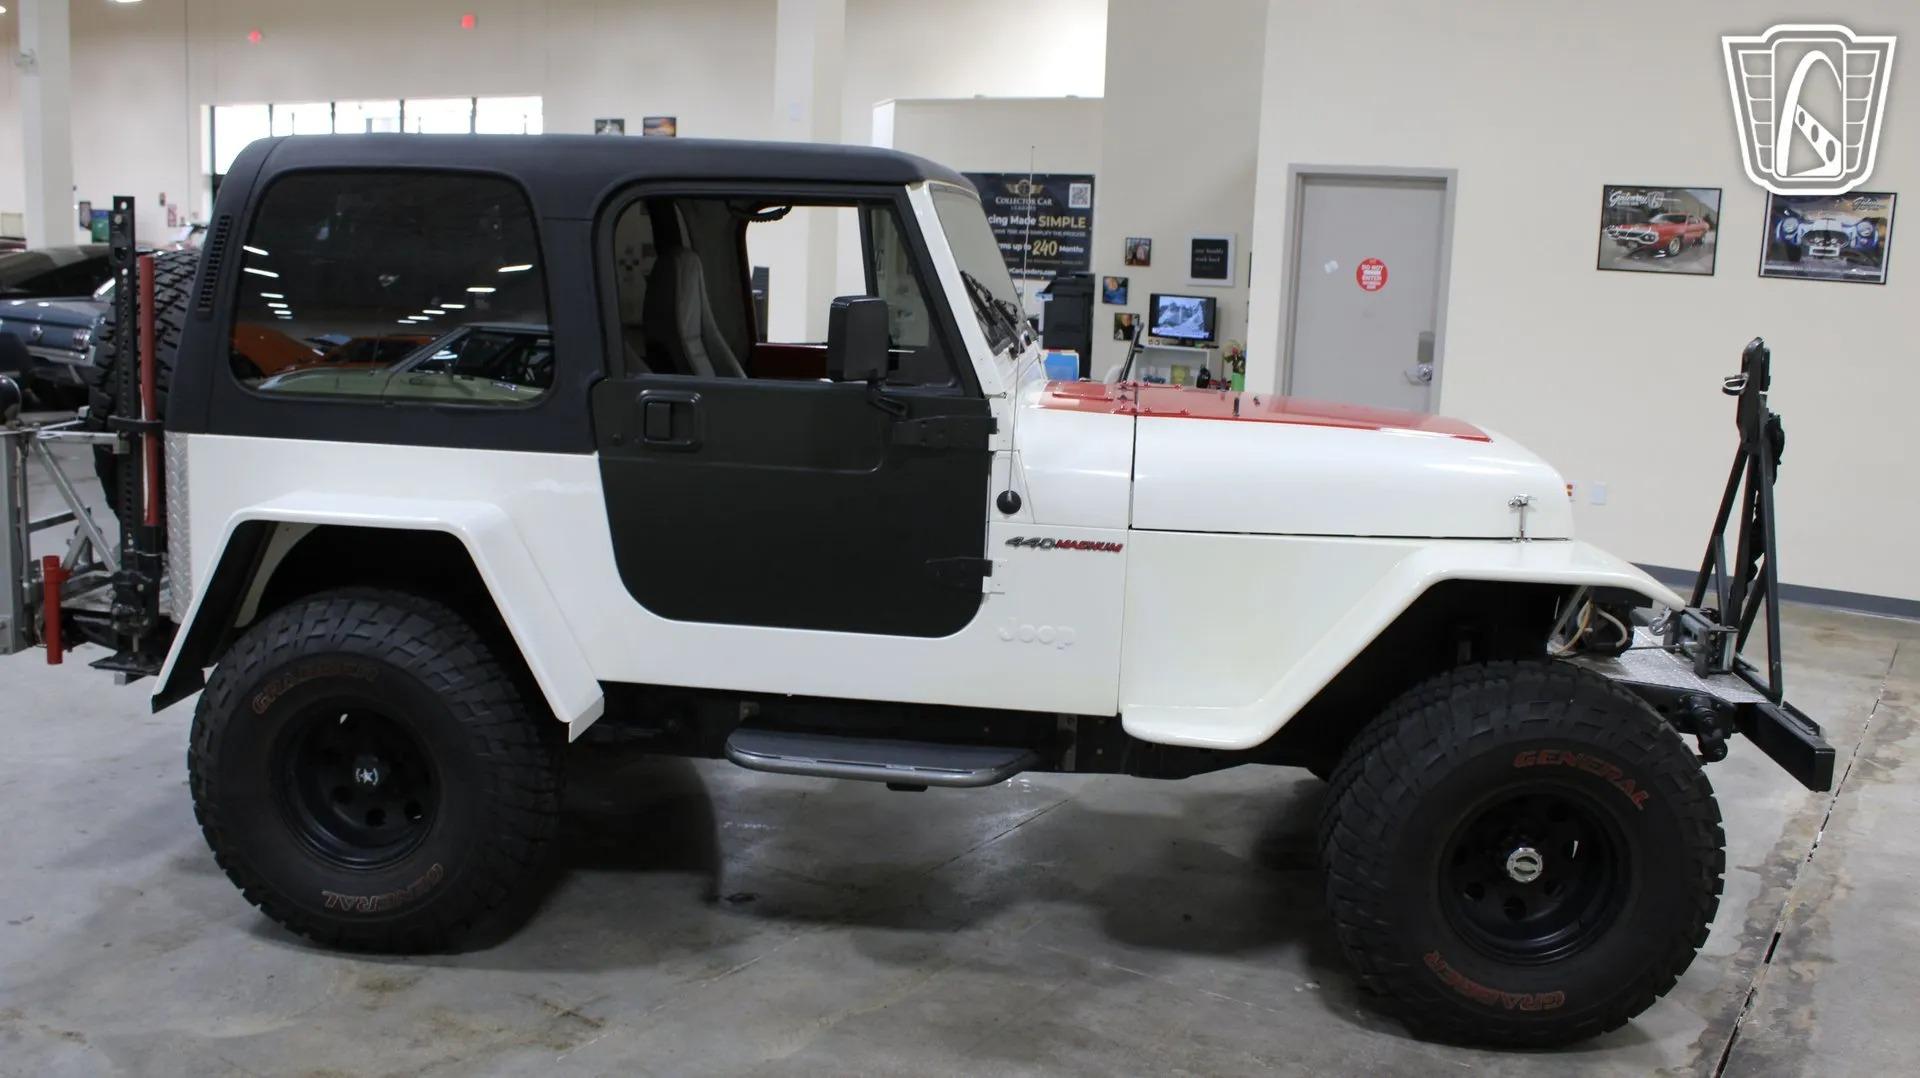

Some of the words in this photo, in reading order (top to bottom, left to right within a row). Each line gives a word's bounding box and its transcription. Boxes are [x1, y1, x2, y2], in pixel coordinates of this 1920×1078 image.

[1010, 215, 1036, 225] Made
[1038, 216, 1086, 228] SIMPLE
[1013, 243, 1022, 252] up
[1032, 240, 1058, 256] 240
[1059, 245, 1084, 253] Months
[1005, 536, 1055, 550] 440
[1055, 538, 1123, 553] MAGNUM
[999, 616, 1076, 651] Jeep
[1513, 749, 1649, 811] GENERAL
